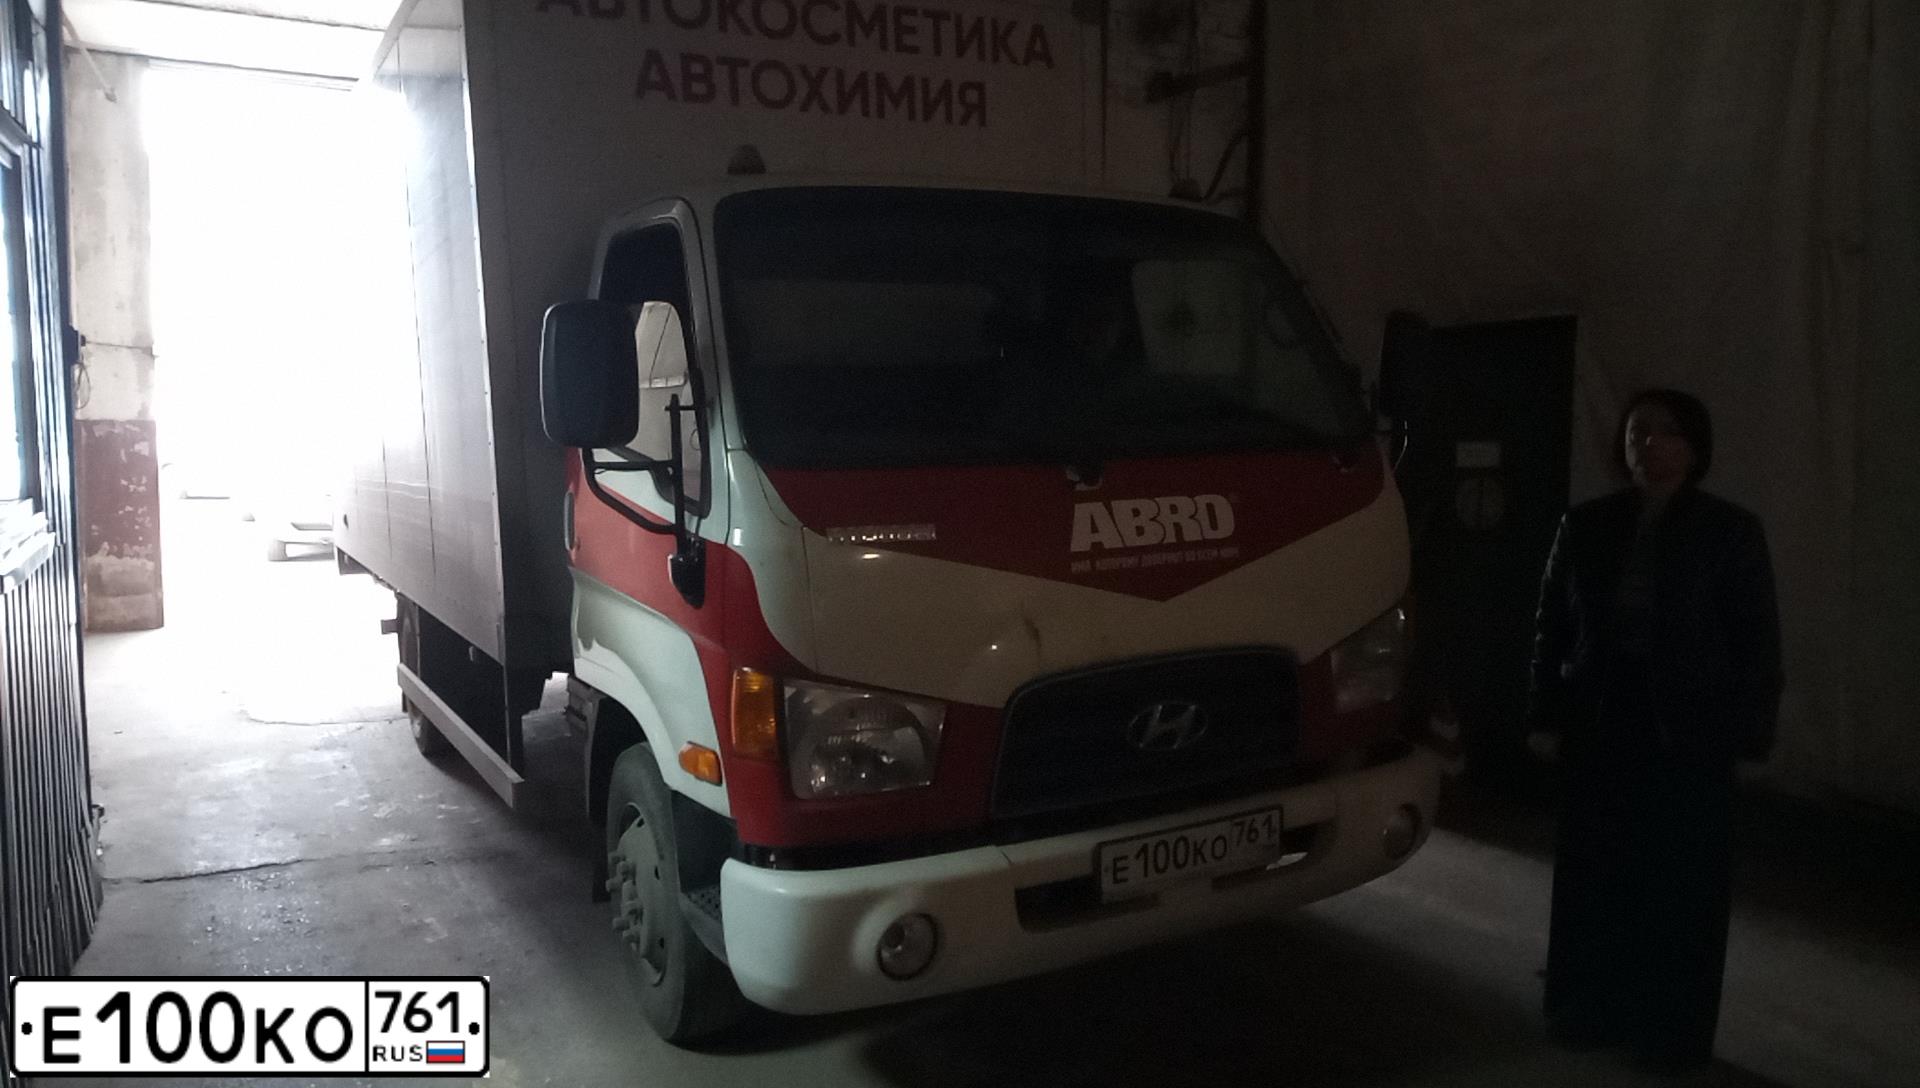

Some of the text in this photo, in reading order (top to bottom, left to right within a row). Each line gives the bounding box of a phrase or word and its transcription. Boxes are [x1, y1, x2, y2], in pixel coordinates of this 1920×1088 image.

[636, 48, 988, 127] АВТОХИМИЯ
[1070, 494, 1235, 552] ABRO
[1233, 814, 1273, 847] 761
